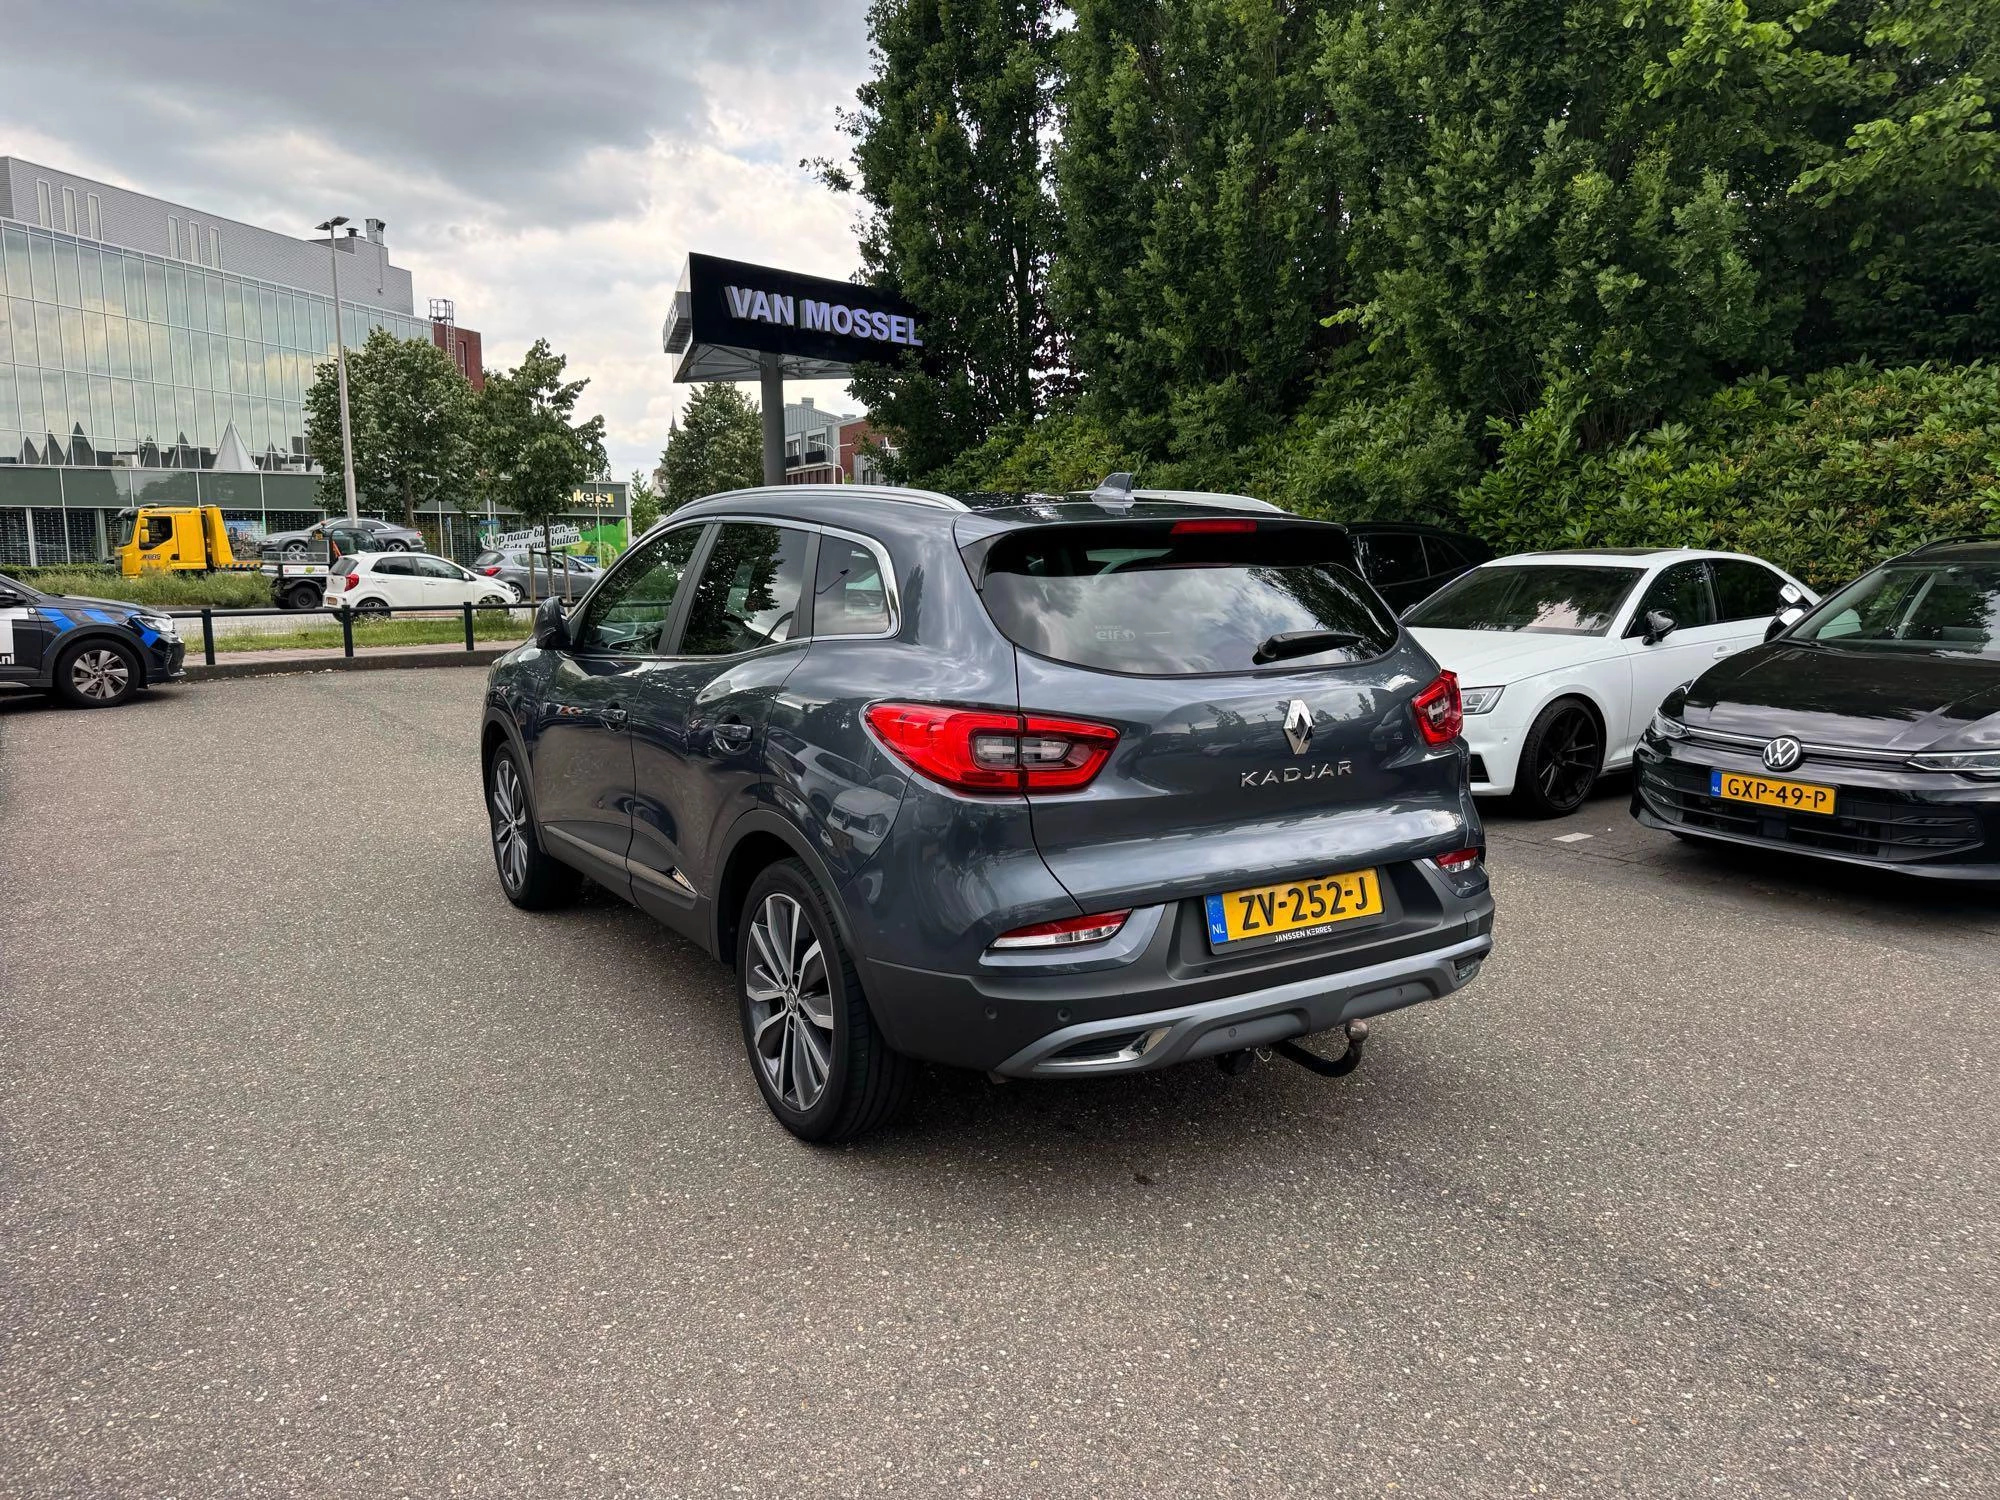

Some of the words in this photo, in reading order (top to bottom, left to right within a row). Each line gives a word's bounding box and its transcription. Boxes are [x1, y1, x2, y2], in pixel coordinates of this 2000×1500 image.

[724, 285, 795, 326] VAN
[799, 299, 923, 346] MOSSEL
[483, 535, 505, 547] Lp
[507, 531, 533, 541] naar
[533, 524, 566, 538] binen
[551, 534, 581, 547] buiten
[1240, 760, 1353, 788] KADJAR
[1728, 778, 1827, 809] GXP-49-P
[1239, 877, 1368, 930] ZV-252-J
[1212, 923, 1226, 936] NL
[1274, 930, 1306, 943] JANSSEN
[1305, 924, 1333, 938] KERRES
